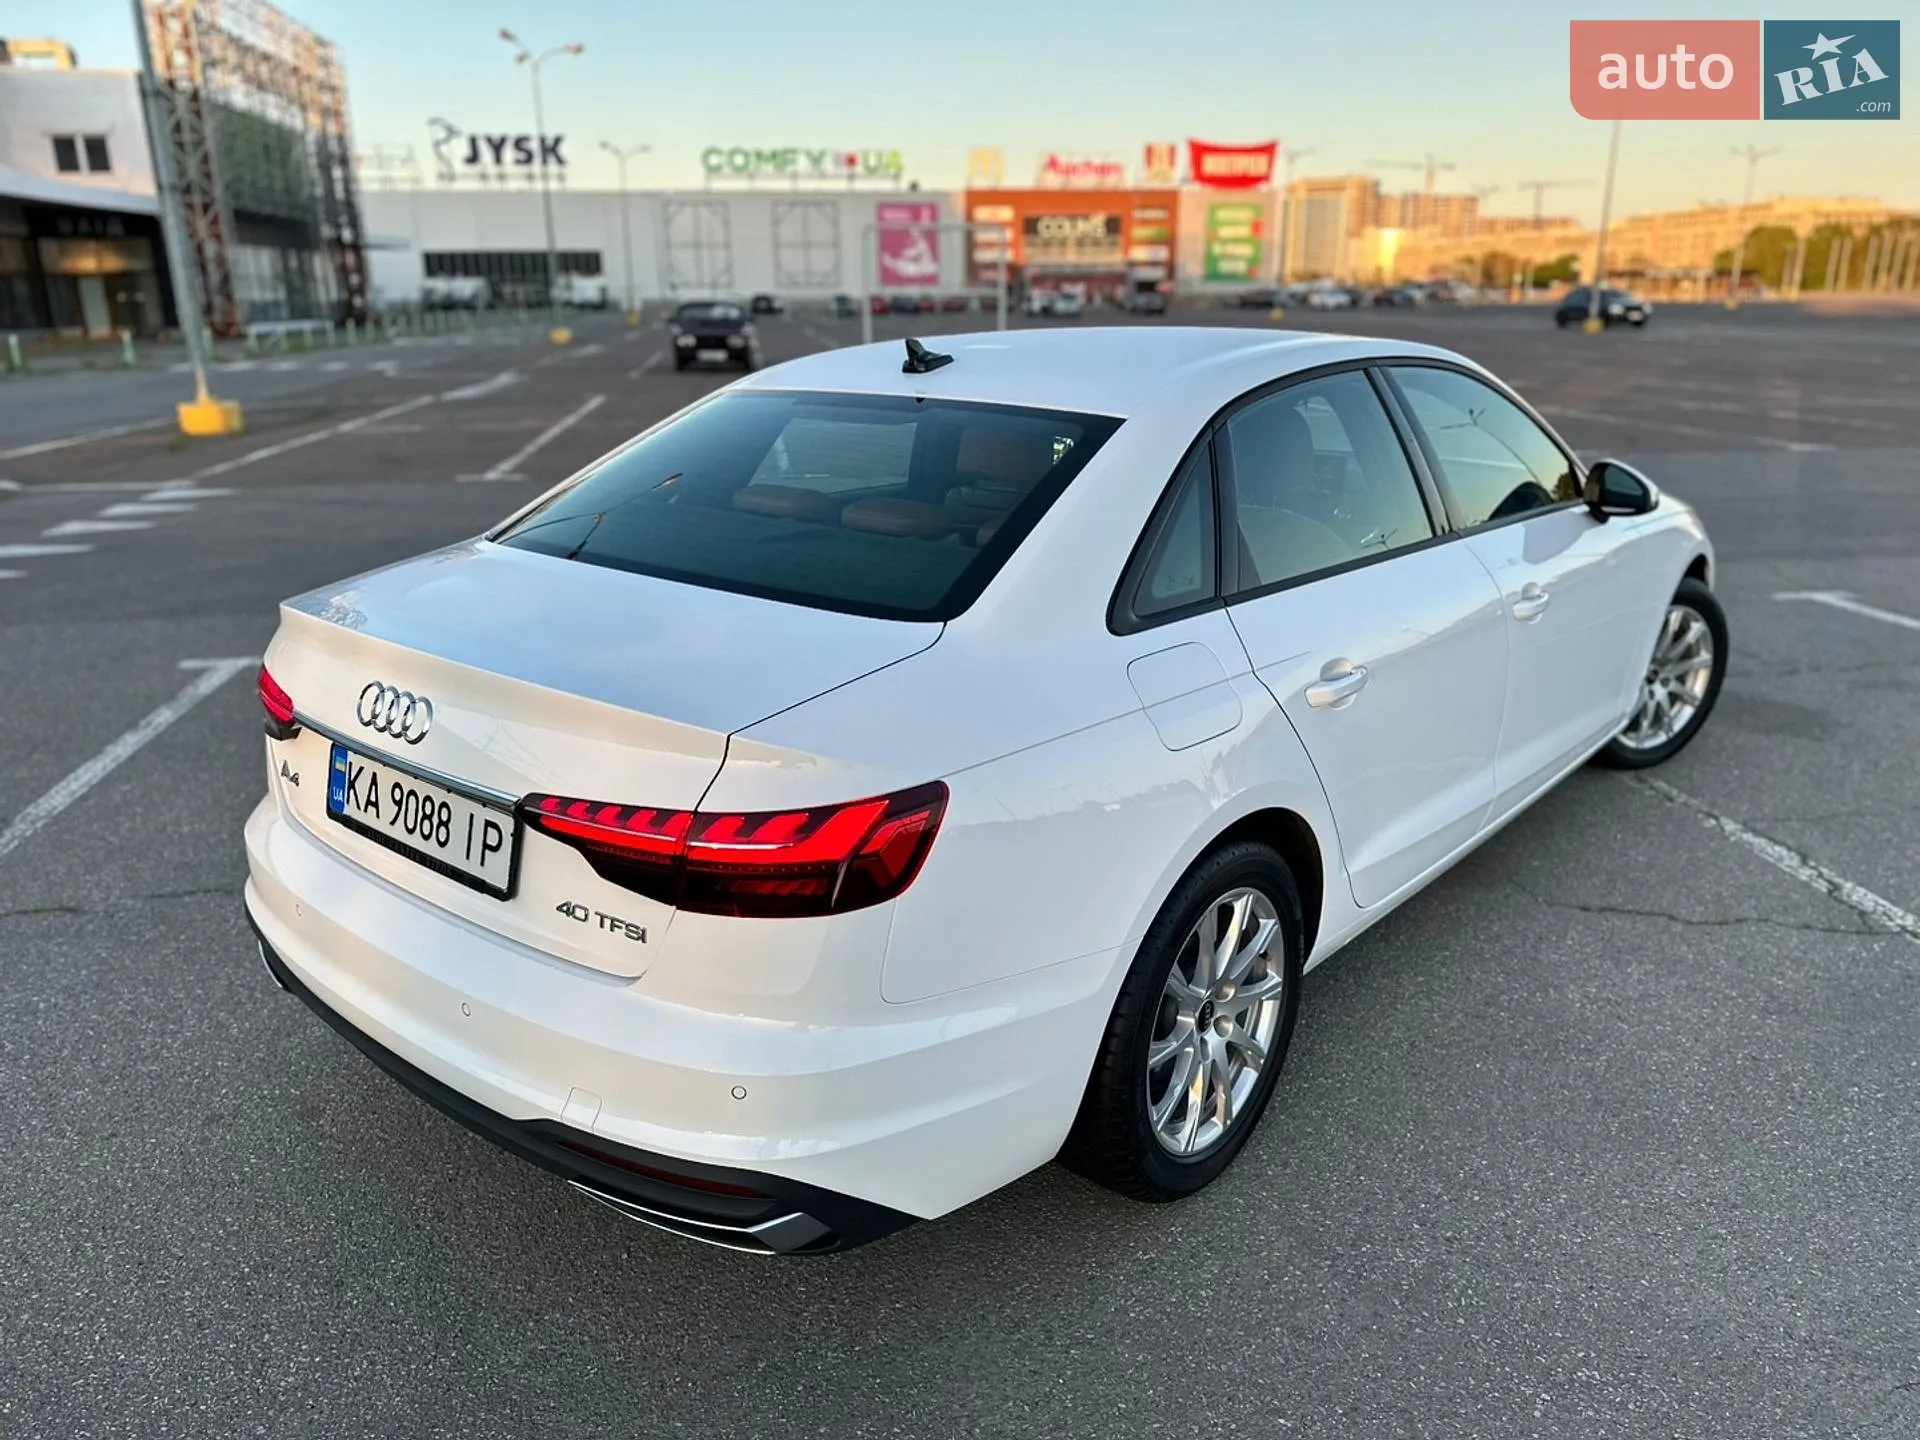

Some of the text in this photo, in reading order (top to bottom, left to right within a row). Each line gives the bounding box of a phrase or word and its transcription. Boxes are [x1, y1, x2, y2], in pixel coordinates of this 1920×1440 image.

[465, 135, 566, 165] JYSK
[701, 147, 826, 174] COMFY
[281, 759, 300, 787] A4
[333, 786, 344, 802] UA
[346, 761, 380, 819] KA
[389, 781, 452, 848] 9088
[465, 812, 503, 867] IP
[556, 900, 648, 943] 40 TFSI
